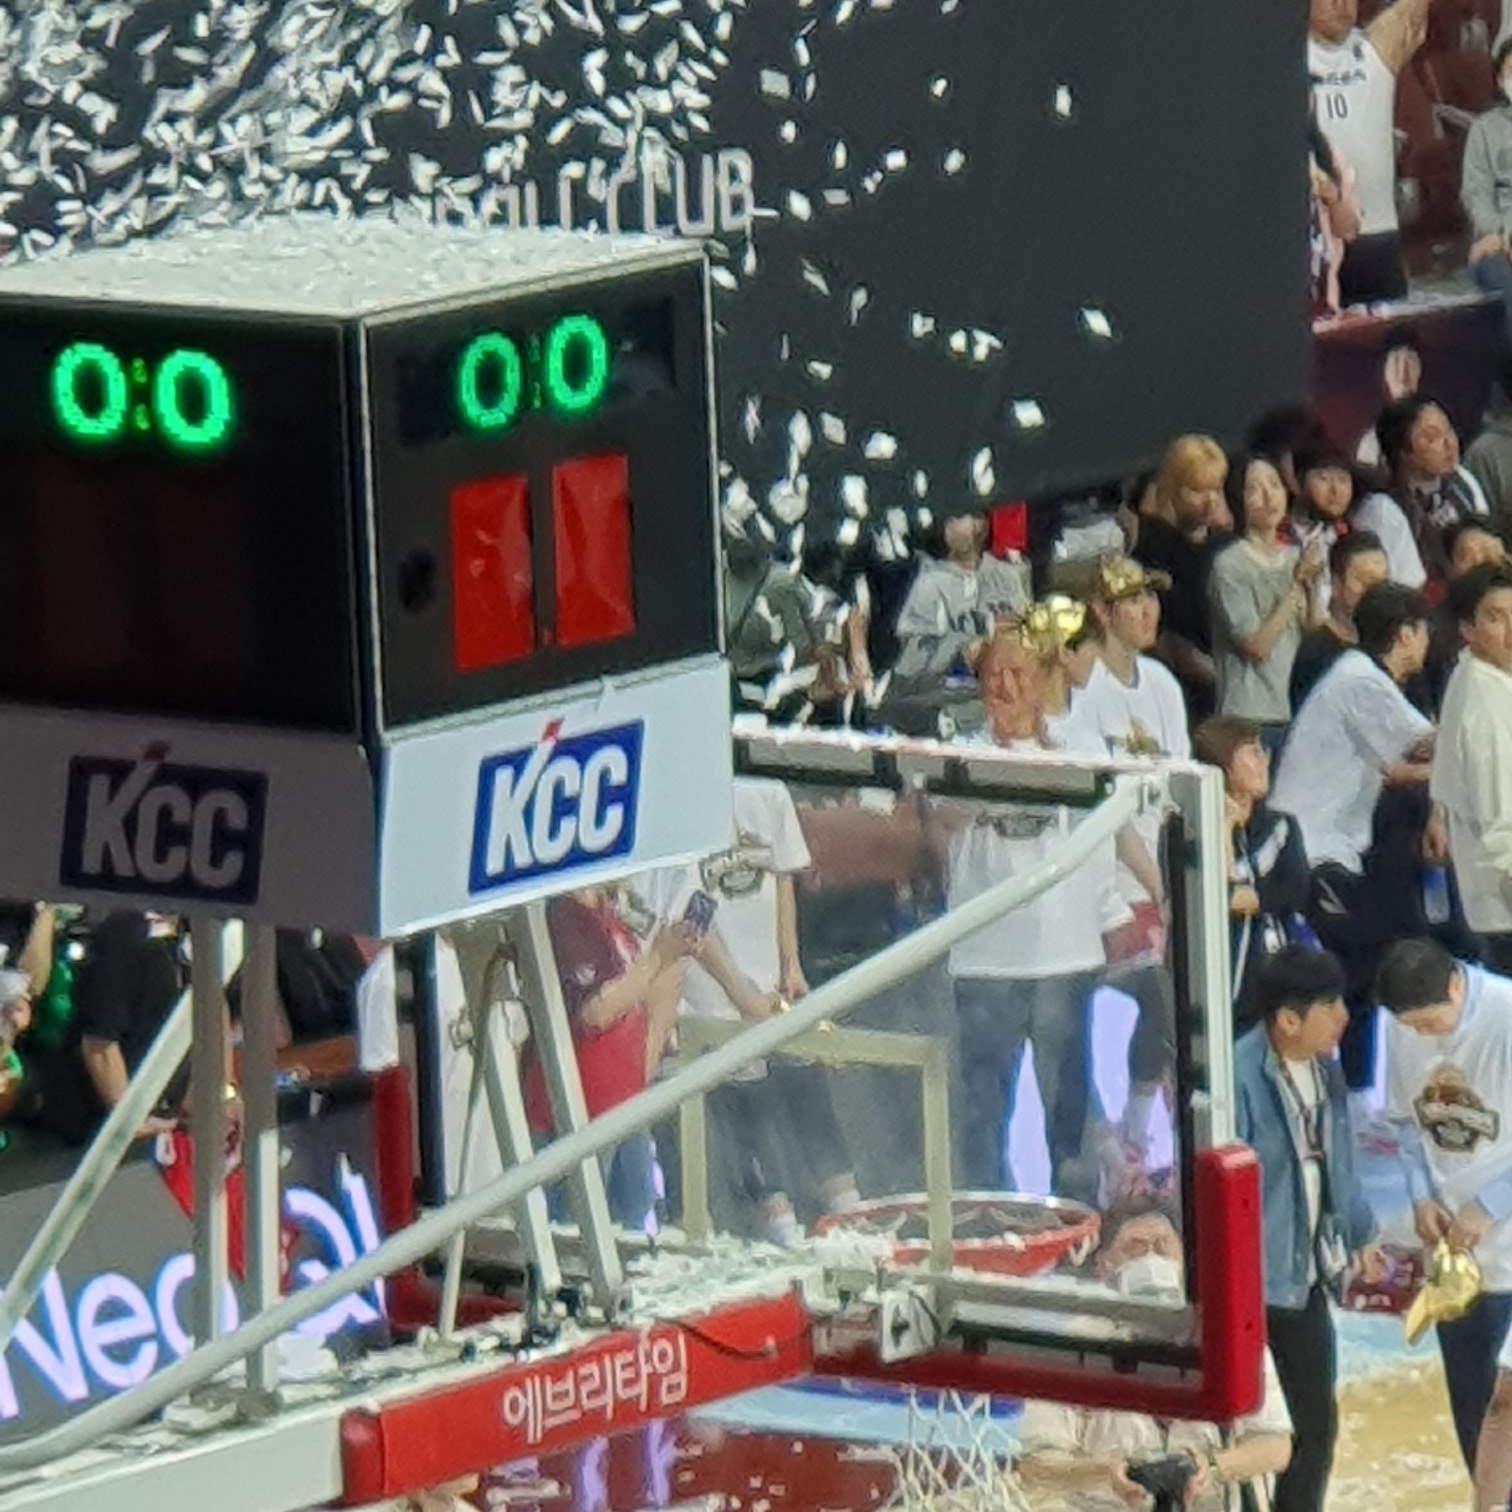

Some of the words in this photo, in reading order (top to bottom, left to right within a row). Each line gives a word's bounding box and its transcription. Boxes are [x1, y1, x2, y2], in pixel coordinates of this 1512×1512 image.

[82, 742, 250, 890] KCC
[486, 719, 629, 879] KCC
[502, 1328, 689, 1445] 에브리타임
